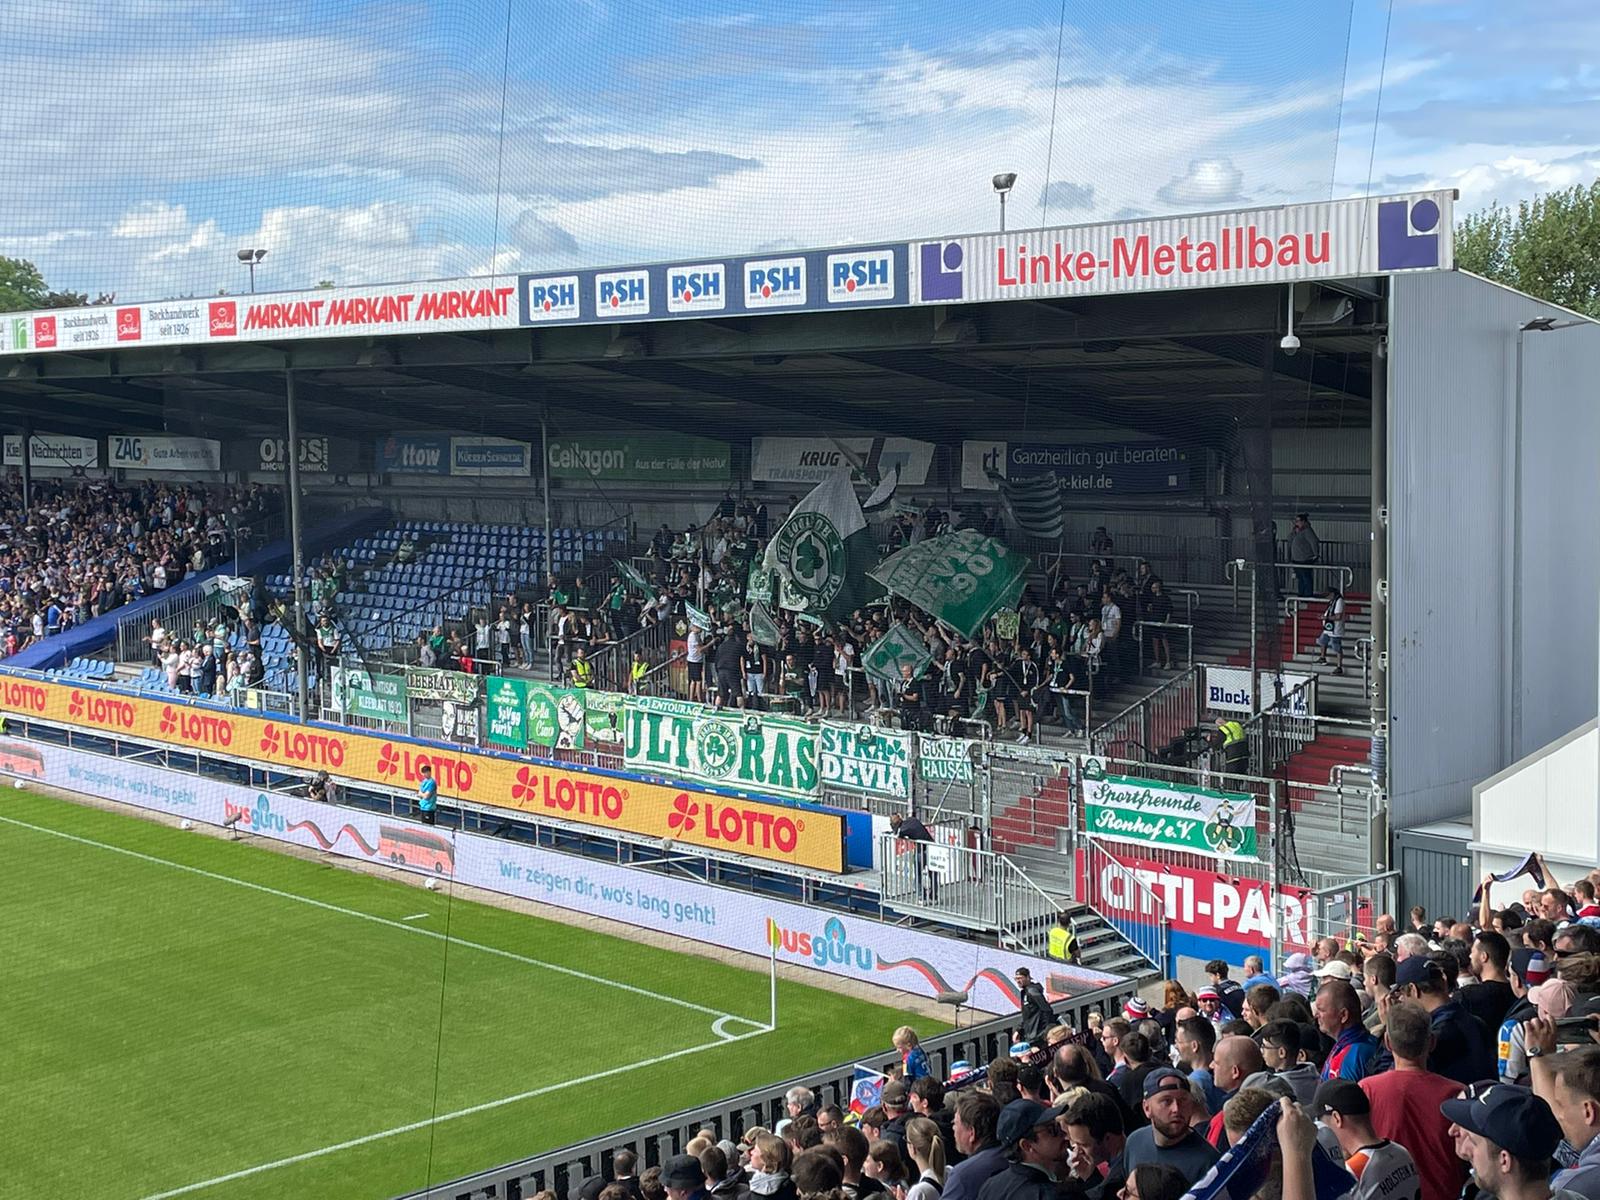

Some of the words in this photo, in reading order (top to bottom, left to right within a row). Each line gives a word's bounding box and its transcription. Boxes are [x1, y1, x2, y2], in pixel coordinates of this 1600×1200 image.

[998, 226, 1332, 287] Linke-Metallbau
[671, 272, 720, 297] RSH
[749, 267, 801, 293] RSH
[833, 259, 888, 287] RSH
[415, 287, 514, 321] MARKANT
[533, 284, 574, 306] RSH
[600, 278, 644, 302] RSH
[149, 307, 200, 321] Backhandwerk
[243, 300, 324, 330] MARKANT
[325, 294, 414, 325] MARKANT
[6, 442, 23, 457] Kiel
[32, 443, 82, 459] Nachrichten
[115, 438, 142, 461] ZAG
[549, 443, 624, 475] Cellagon
[800, 451, 841, 466] KRUG
[1012, 448, 1092, 465] Ganzheitlich
[1096, 450, 1120, 469] gut
[769, 468, 833, 481] TRANSPORT
[4, 681, 46, 711] LOTTO
[1210, 687, 1250, 705] Block
[87, 698, 134, 728] LOTTO
[180, 714, 232, 746] LOTTO
[284, 732, 344, 767] LOTTO
[404, 750, 473, 792] LOTTO
[822, 754, 906, 792] DEVIA
[922, 759, 973, 780] HAUSEN
[543, 775, 623, 820] LOTTO
[1093, 782, 1202, 813] Sportfreunde
[704, 803, 798, 852] LOTTO
[1095, 808, 1162, 840] Ronhof
[499, 860, 521, 880] Wir
[524, 866, 569, 893] zeigen
[601, 884, 633, 904] wo's
[637, 889, 670, 916] lang
[674, 895, 716, 924] geht!
